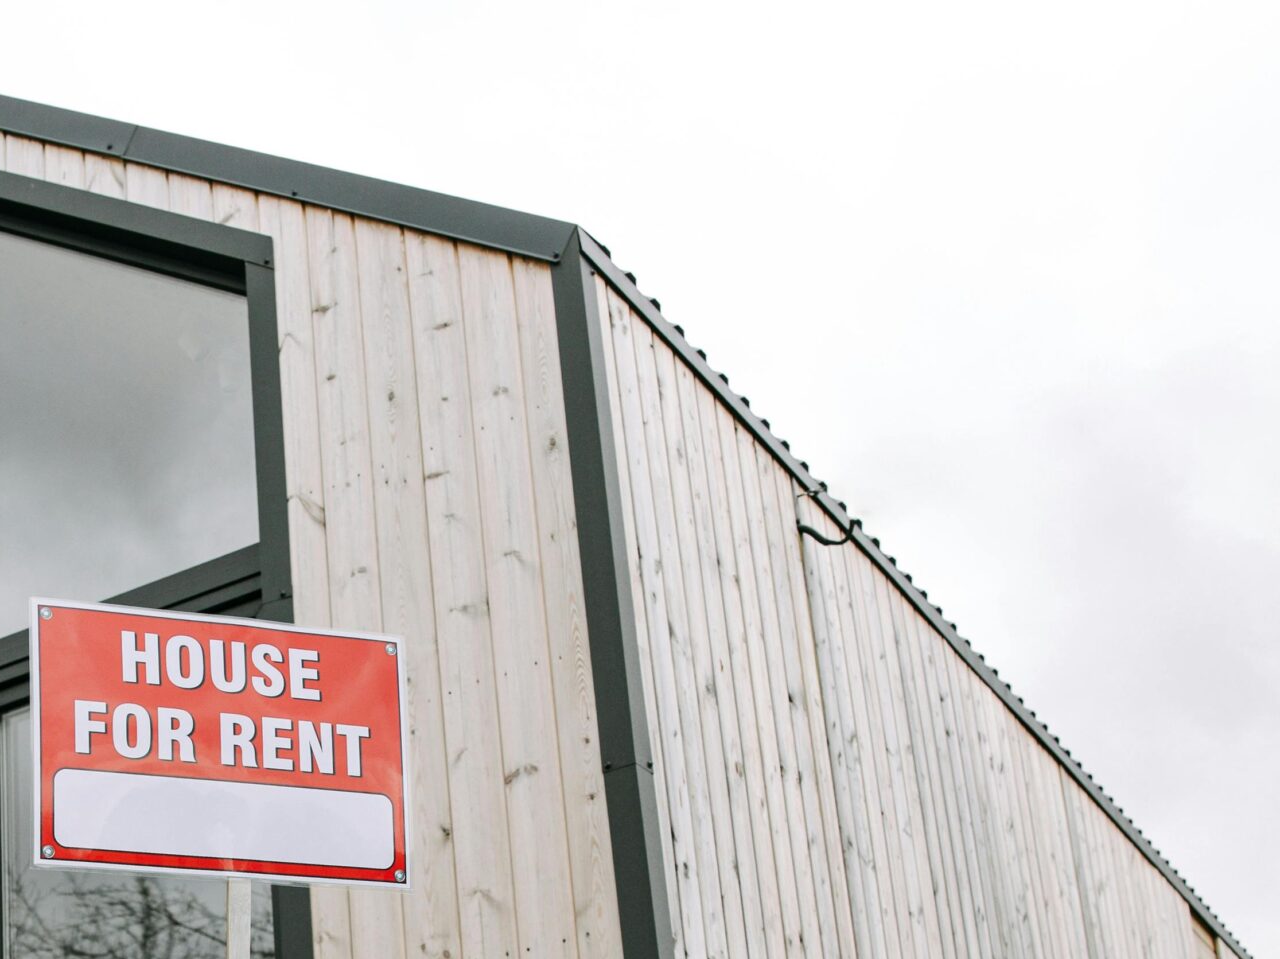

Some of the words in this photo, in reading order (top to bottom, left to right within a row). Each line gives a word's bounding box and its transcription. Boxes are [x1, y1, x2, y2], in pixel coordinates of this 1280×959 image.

[120, 630, 322, 702] HOUSE
[73, 699, 197, 763] FOR
[219, 712, 371, 777] RENT
